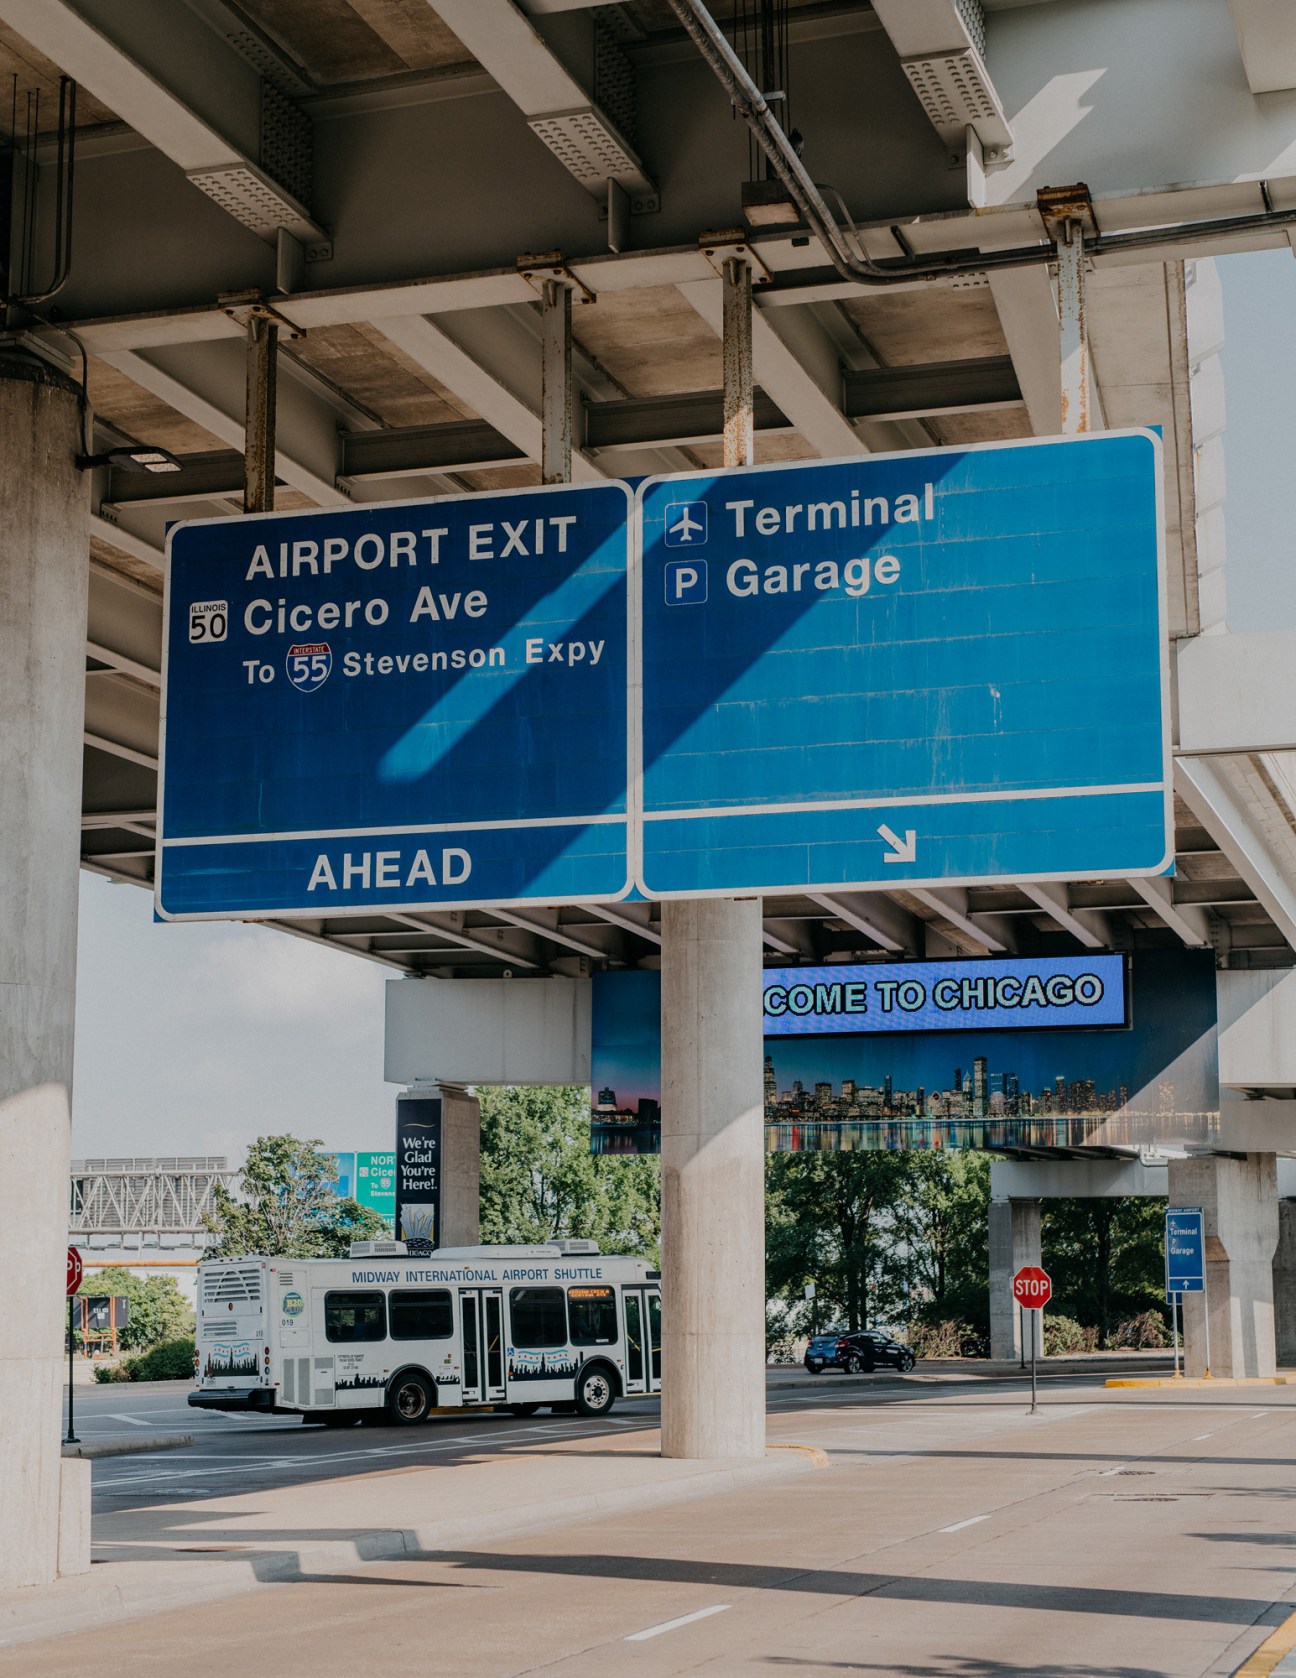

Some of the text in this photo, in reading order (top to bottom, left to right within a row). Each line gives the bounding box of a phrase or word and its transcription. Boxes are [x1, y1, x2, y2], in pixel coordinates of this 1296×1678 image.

[726, 483, 934, 537] Terminal
[245, 516, 577, 581] AIRPORT EXIT
[676, 555, 901, 598] P Garage
[191, 603, 226, 613] ILLINOIS
[244, 586, 488, 635] Cicero Ave
[190, 613, 226, 640] 50
[293, 646, 325, 654] INTERSTATE
[243, 639, 605, 684] To 55 Stevenson Expy
[307, 848, 472, 891] AHEAD
[763, 973, 1104, 1017] COME TO CHICAGO
[403, 1136, 436, 1149] We're
[370, 1156, 396, 1165] NOR
[404, 1150, 432, 1163] Glad
[401, 1165, 436, 1176] You're
[1170, 1228, 1198, 1236] Terminal
[1170, 1247, 1194, 1255] Garage
[352, 1268, 602, 1283] MIDWAY INTERNATIONAL AIRPORT SHUTTLE
[1015, 1279, 1049, 1296] STOP
